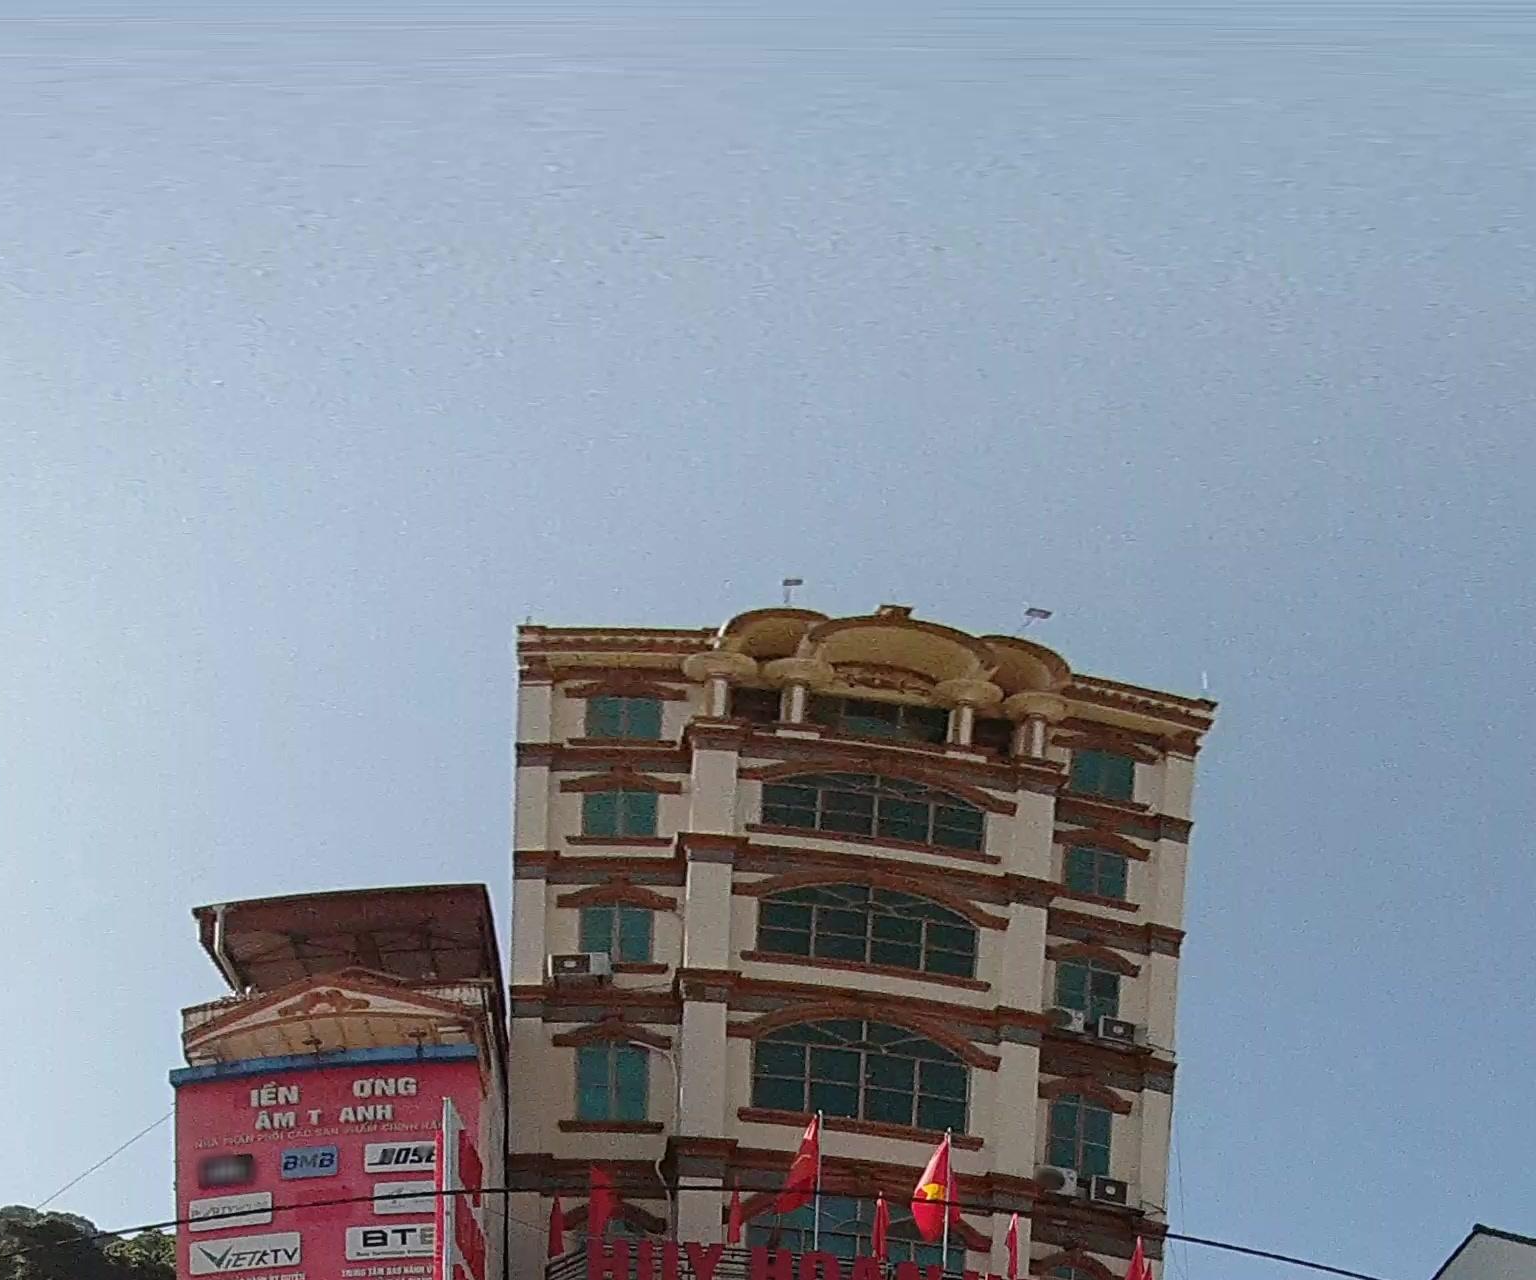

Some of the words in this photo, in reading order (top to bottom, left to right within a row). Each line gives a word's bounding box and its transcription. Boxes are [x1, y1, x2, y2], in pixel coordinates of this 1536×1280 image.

[255, 1109, 296, 1131] ÂM
[339, 1104, 394, 1123] ANH
[283, 1151, 335, 1172] BMB
